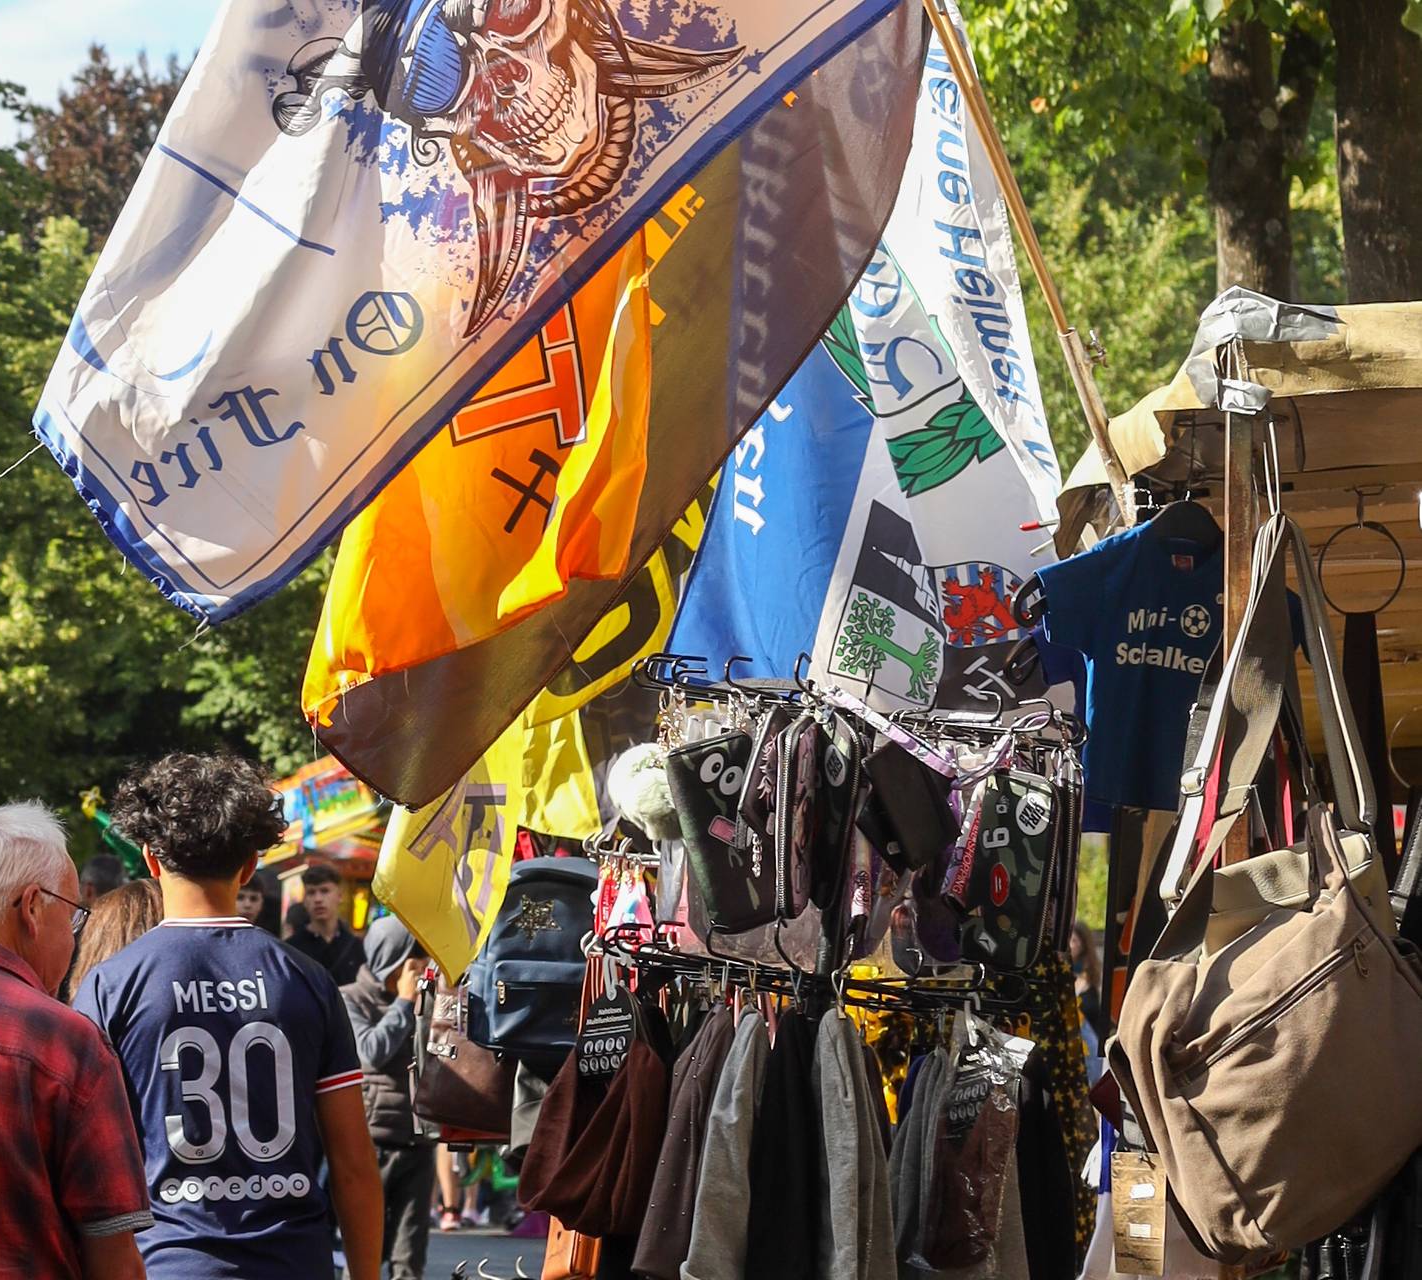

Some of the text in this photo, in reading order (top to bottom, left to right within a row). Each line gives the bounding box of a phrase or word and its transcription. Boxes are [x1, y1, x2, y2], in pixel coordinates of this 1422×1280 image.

[1127, 606, 1177, 634] Mni-
[160, 1021, 296, 1165] 30
[159, 1172, 310, 1204] ooredoo
